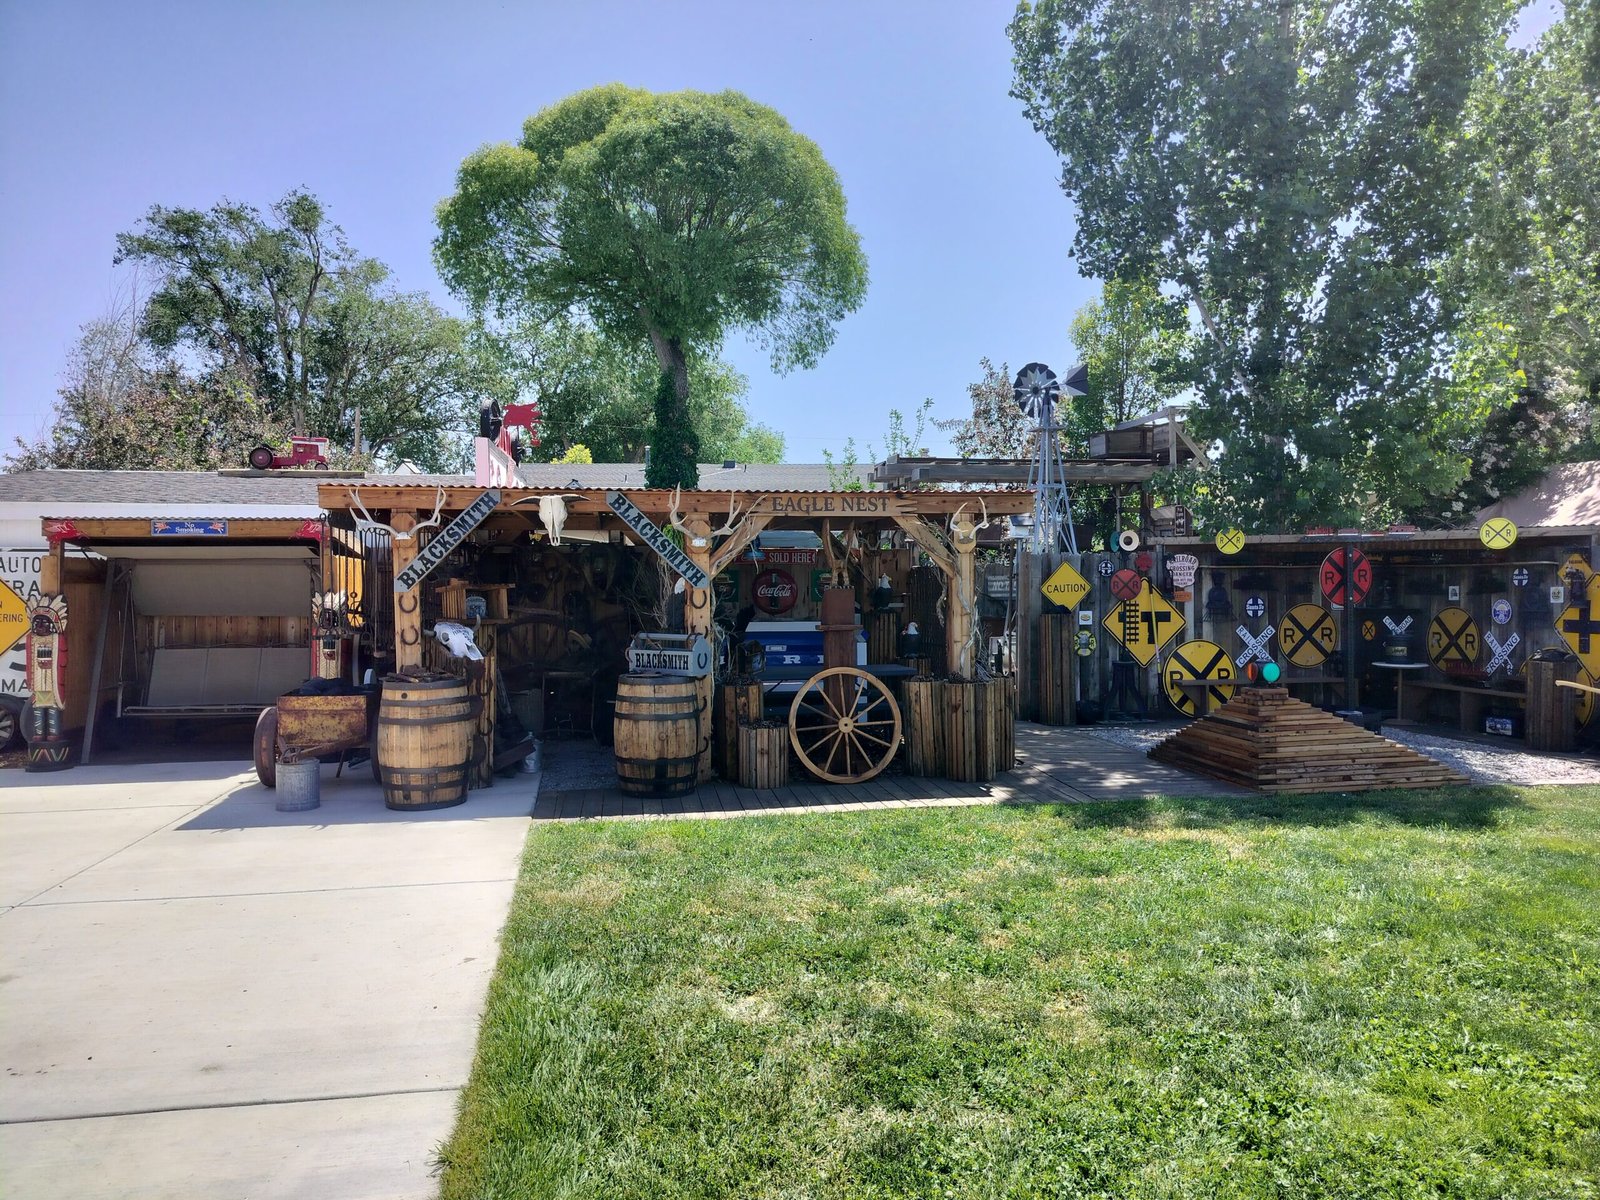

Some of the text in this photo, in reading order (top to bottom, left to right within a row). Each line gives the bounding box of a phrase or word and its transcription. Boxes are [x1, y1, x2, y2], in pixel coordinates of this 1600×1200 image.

[771, 496, 891, 515] EAGLE NEST
[175, 526, 205, 534] Smoking
[1485, 528, 1511, 538] R R
[397, 492, 499, 590] BLACKSMITH
[610, 494, 706, 587] BLACKSMITH
[1219, 536, 1241, 544] R R
[769, 552, 812, 563] SOLD HERE
[1113, 579, 1139, 589] R R
[1324, 569, 1368, 585] R R
[1046, 583, 1086, 594] CAUTION
[1283, 626, 1332, 643] R R
[1432, 631, 1475, 650] R R
[1238, 627, 1274, 665] CROSSING
[635, 652, 689, 671] BLACKSMITH
[1485, 635, 1518, 675] CROSSING
